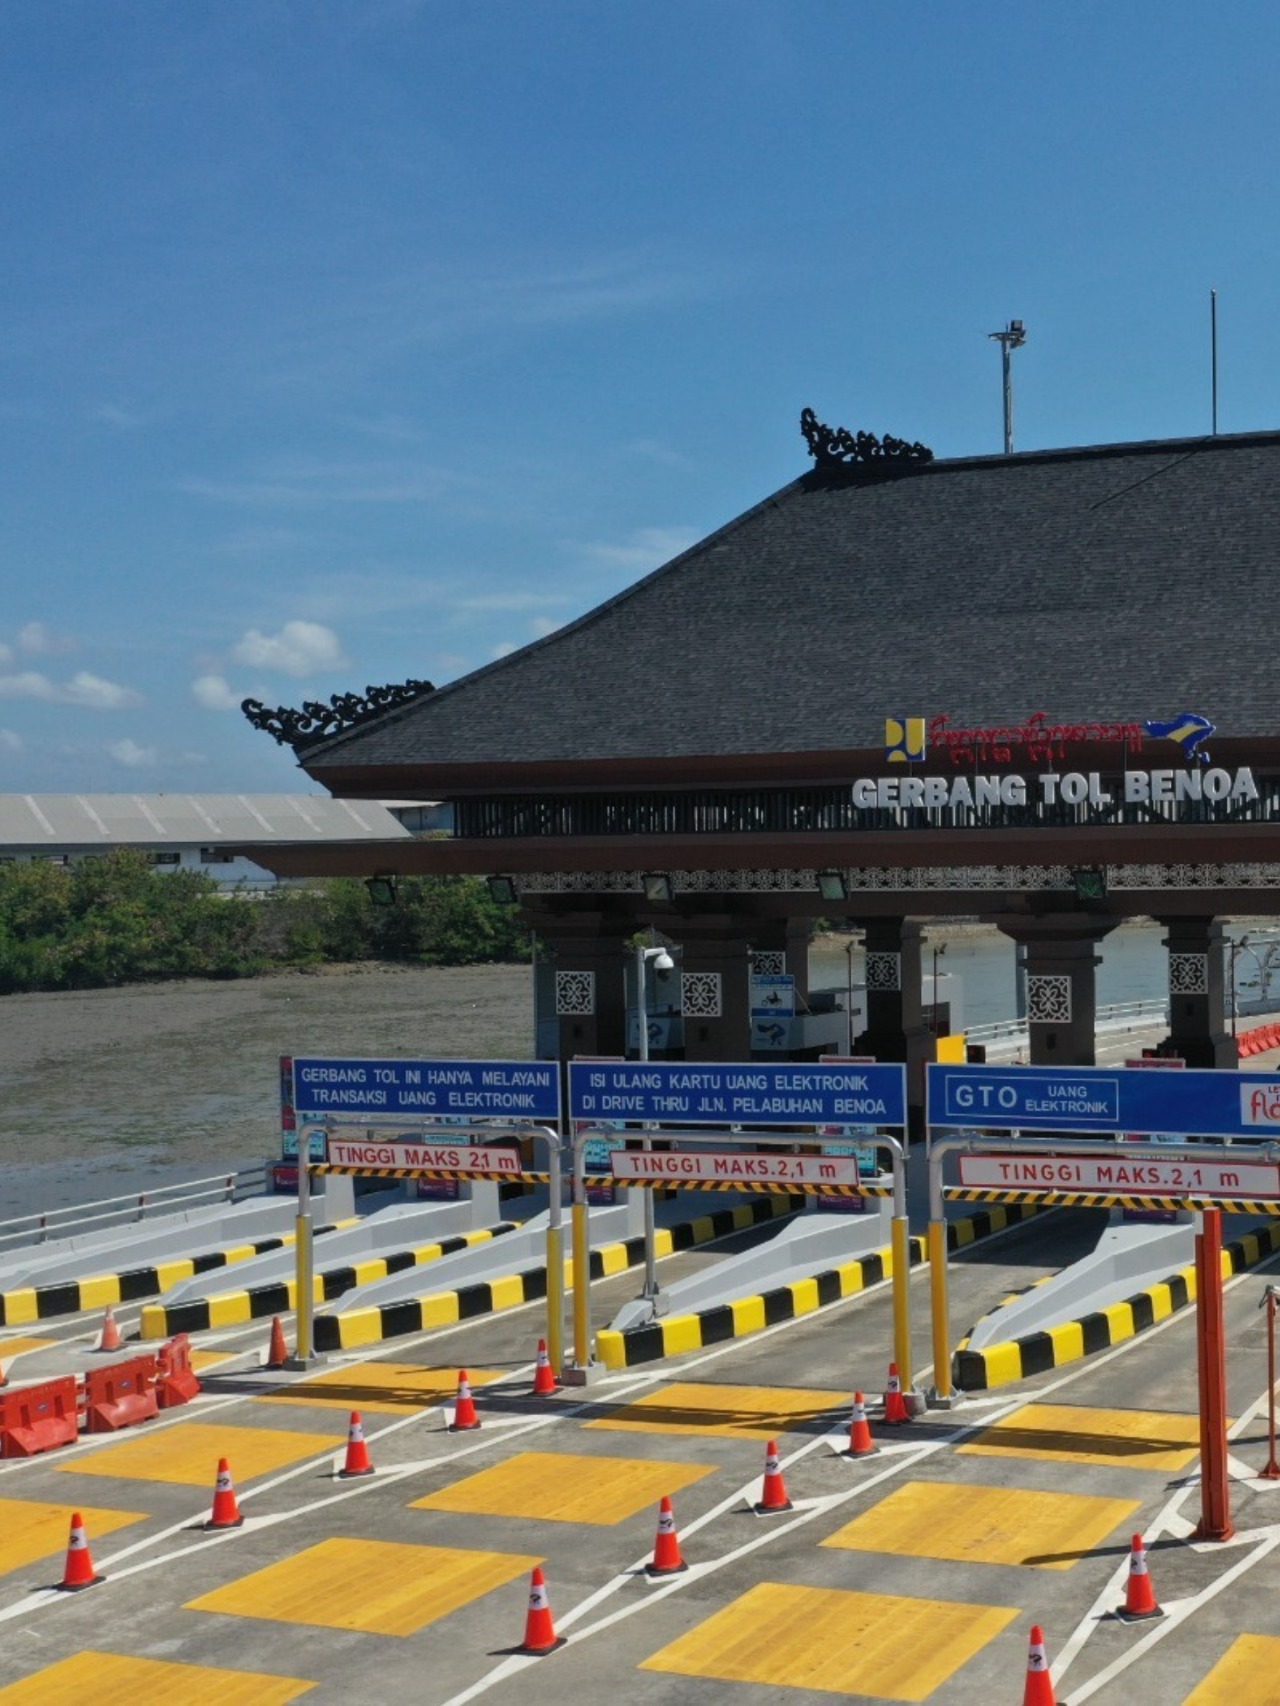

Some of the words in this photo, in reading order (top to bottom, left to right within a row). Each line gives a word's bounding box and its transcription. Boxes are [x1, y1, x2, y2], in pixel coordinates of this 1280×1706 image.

[852, 774, 1026, 809] GERBANG
[1039, 773, 1111, 805] TOL
[1124, 766, 1260, 803] BENOA
[302, 1068, 366, 1083] GERBANG
[374, 1069, 399, 1084] TOL
[406, 1070, 421, 1084] INI
[428, 1070, 473, 1086] HANYA
[482, 1071, 550, 1087] MELAYANI
[590, 1073, 605, 1088] ISI
[613, 1073, 661, 1089] ULANG
[669, 1074, 720, 1090] KARTU
[726, 1075, 768, 1090] UANG
[775, 1075, 869, 1092] ELEKTRONIK
[311, 1089, 387, 1104] TRANSAKSI
[399, 1091, 436, 1106] UANG
[448, 1092, 535, 1108] ELEKTRONIK
[956, 1085, 1018, 1108] GTO
[1048, 1085, 1087, 1098] UANG
[583, 1095, 596, 1110] DI
[602, 1095, 645, 1111] DRIVE
[652, 1096, 689, 1112] THRU
[697, 1097, 727, 1113] JLN.
[733, 1098, 823, 1114] PELABUHAN
[834, 1099, 886, 1115] BENOA
[1025, 1099, 1108, 1114] ELEKTRONIK
[335, 1146, 395, 1164] TINGGI
[405, 1149, 460, 1167] MAKS
[469, 1152, 490, 1171] 2,1
[498, 1155, 515, 1170] m
[630, 1156, 701, 1174] TINGGI
[819, 1165, 836, 1178] m
[999, 1163, 1082, 1182] TINGGI
[1219, 1172, 1240, 1187] m
